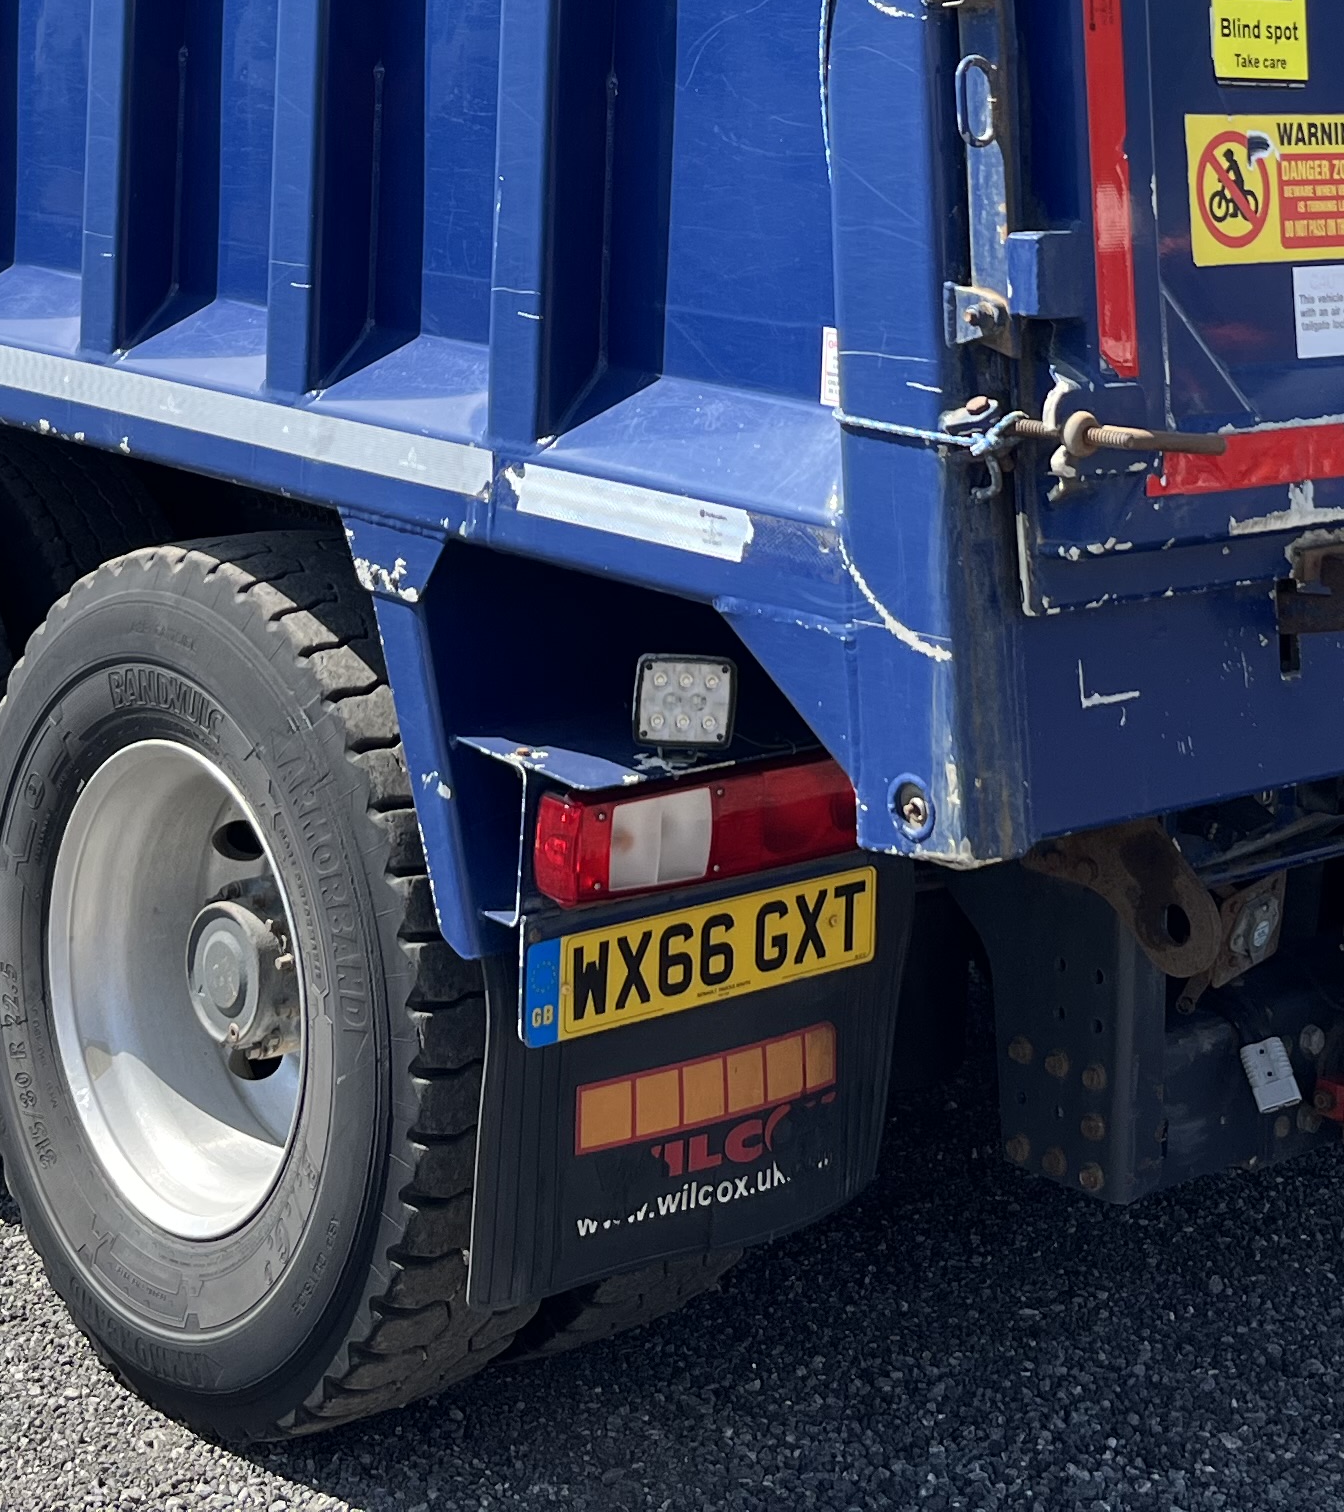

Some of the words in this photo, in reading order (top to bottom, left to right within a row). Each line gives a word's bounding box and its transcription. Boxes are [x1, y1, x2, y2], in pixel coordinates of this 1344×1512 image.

[1220, 17, 1261, 39] Blind
[1265, 21, 1299, 45] spot
[1234, 53, 1260, 69] Take
[1262, 57, 1287, 69] care
[1281, 159, 1331, 180] DANGER
[1297, 200, 1306, 213] IS
[1298, 294, 1316, 305] This
[1317, 292, 1344, 304] vehicle
[1300, 308, 1316, 318] with
[1318, 308, 1329, 317] an
[572, 912, 735, 1022] WX66
[755, 878, 868, 974] GXT
[531, 1004, 554, 1029] GB
